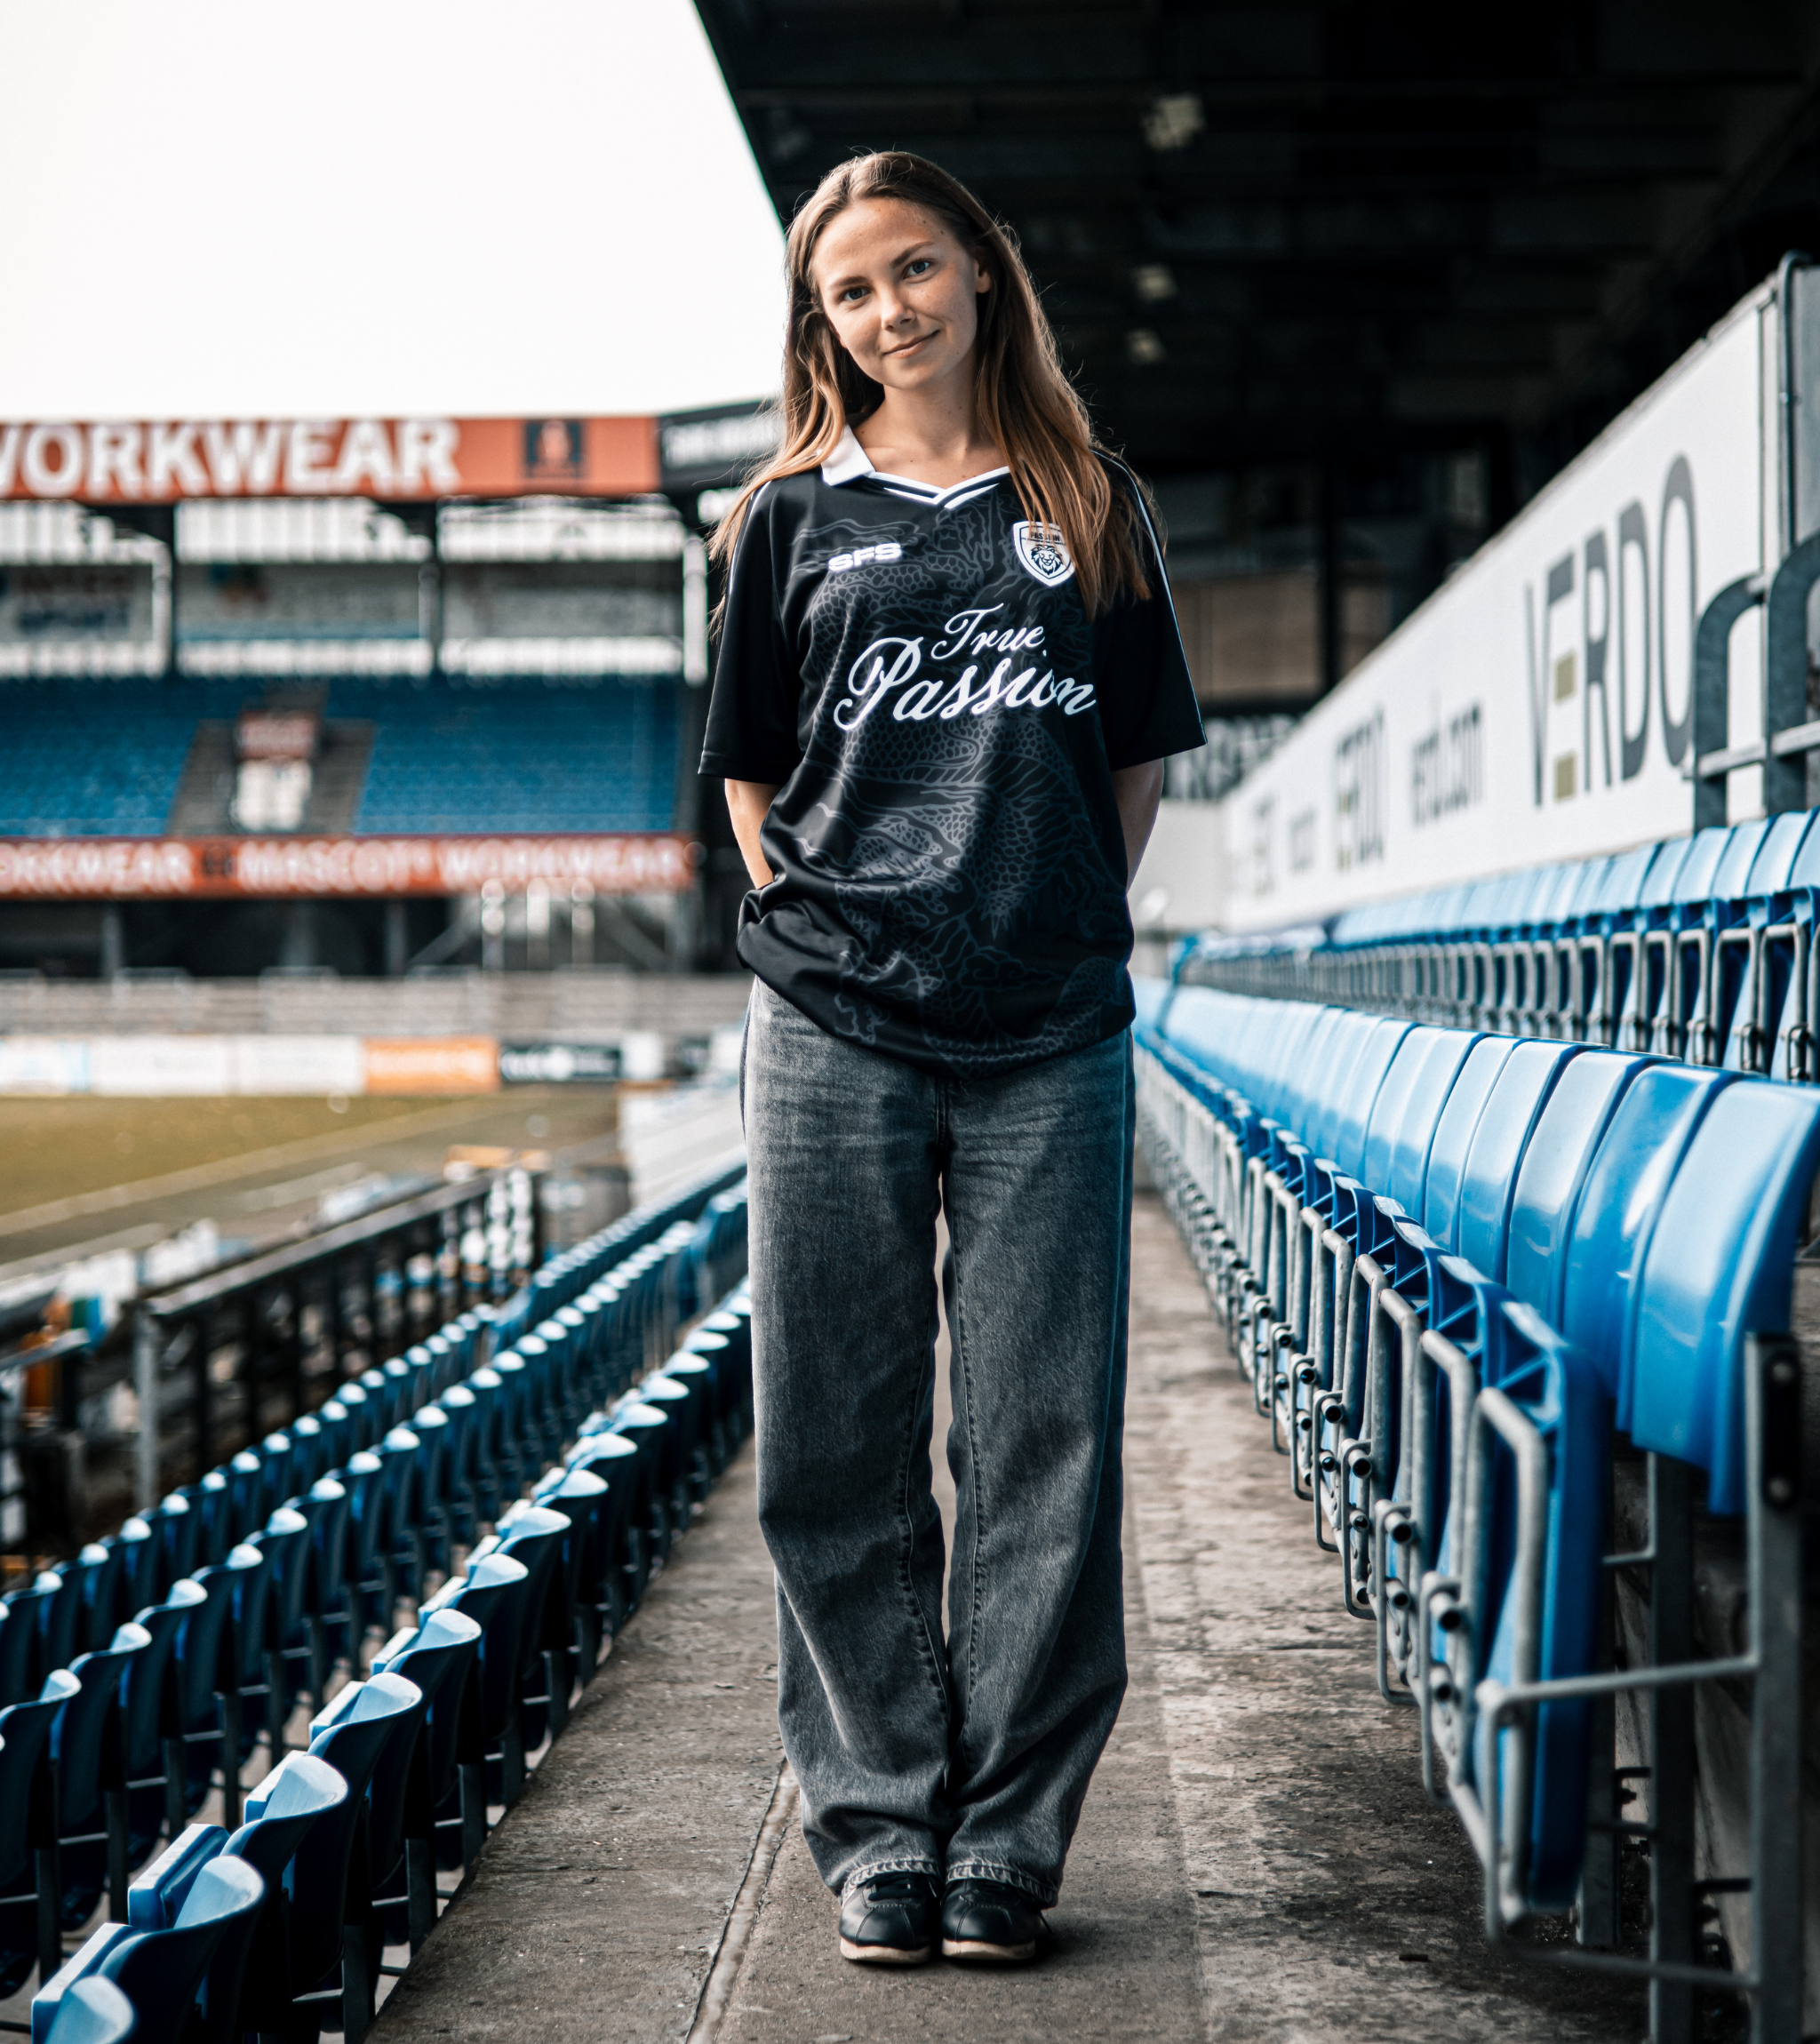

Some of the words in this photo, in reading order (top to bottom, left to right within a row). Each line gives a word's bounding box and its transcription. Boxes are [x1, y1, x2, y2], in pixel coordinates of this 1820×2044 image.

[0, 424, 461, 496] ORKWEAR
[828, 542, 902, 571] SFS
[930, 603, 1046, 659] True
[1525, 453, 1697, 809] VERDO
[834, 636, 1097, 731] Passion
